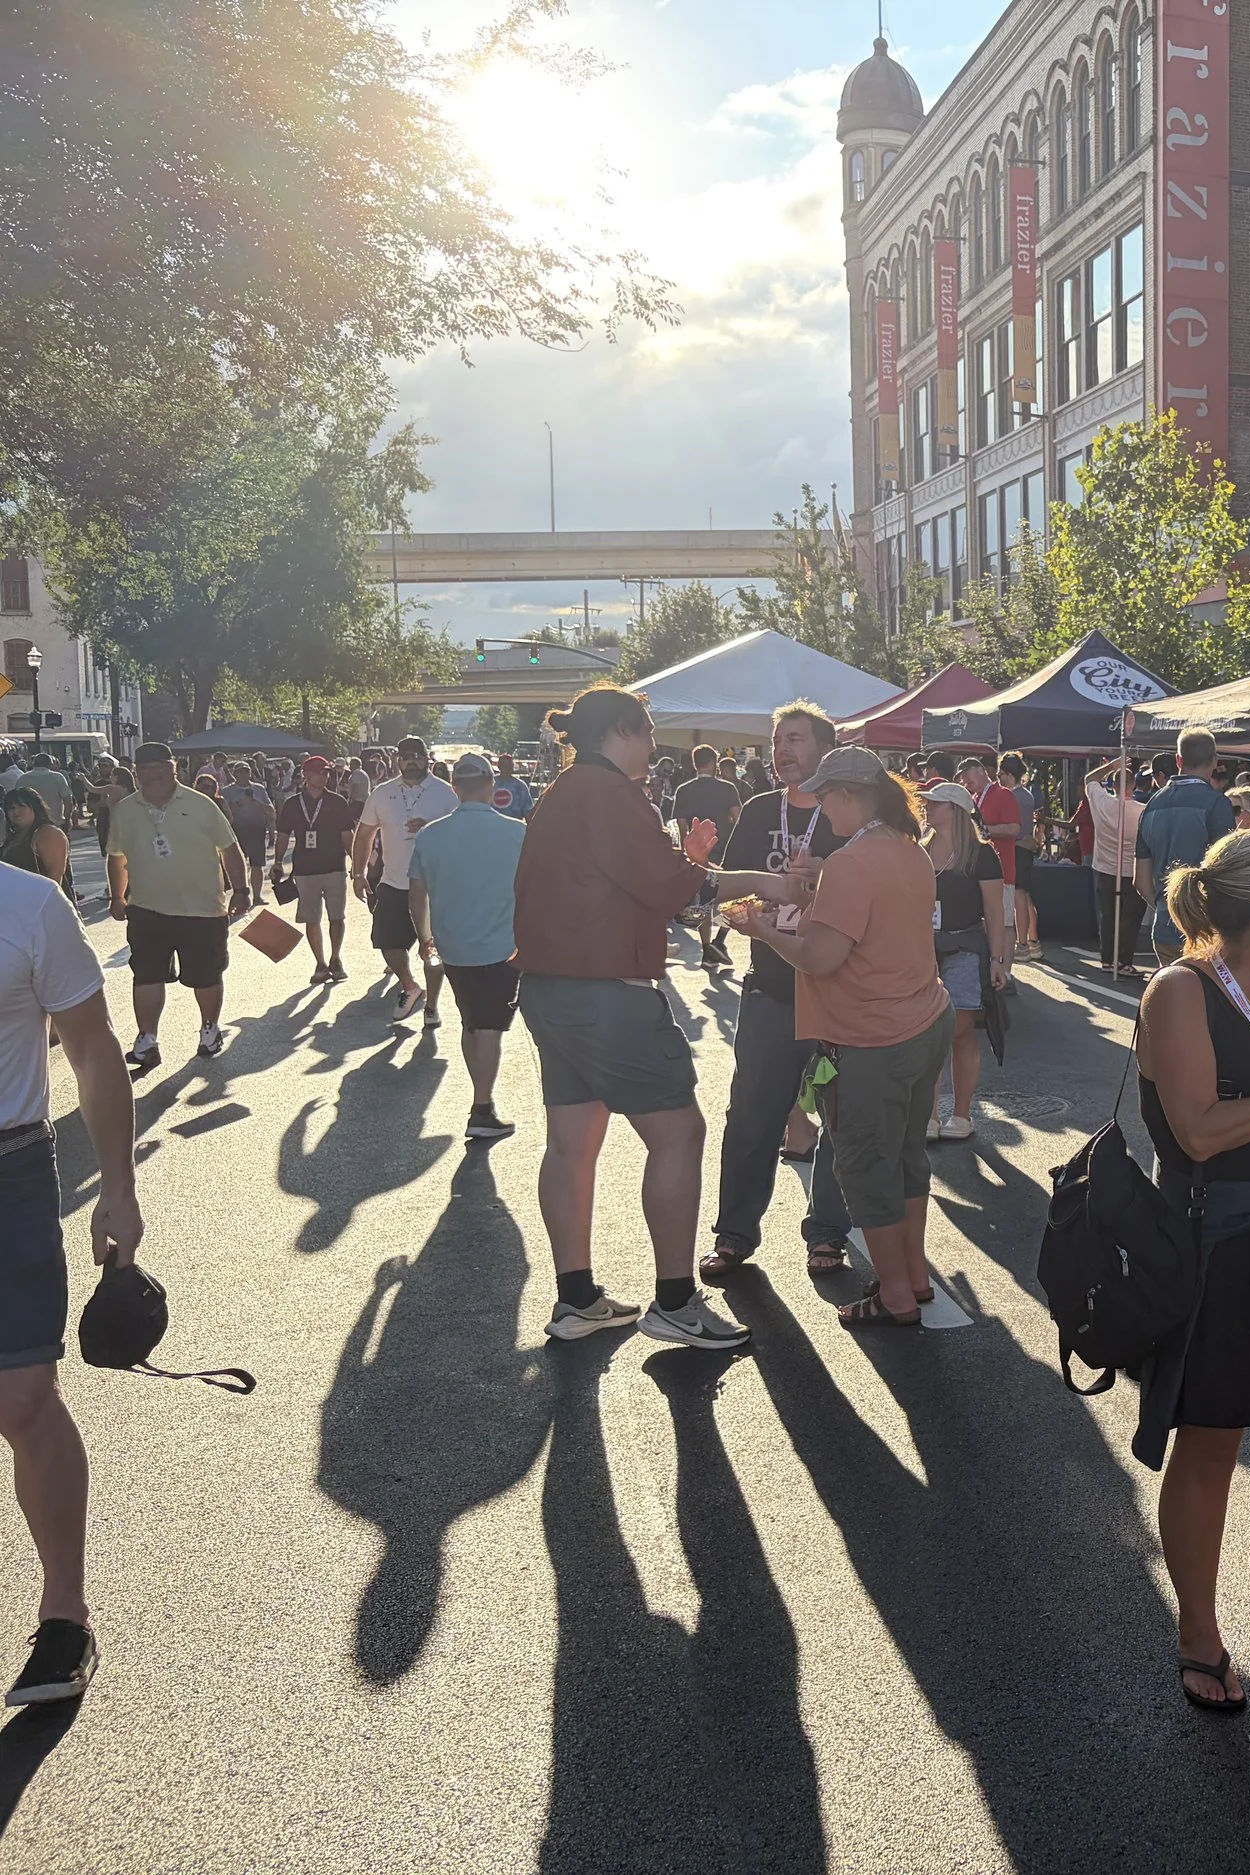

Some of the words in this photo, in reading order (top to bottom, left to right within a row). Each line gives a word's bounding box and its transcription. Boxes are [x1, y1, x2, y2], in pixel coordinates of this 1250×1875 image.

[1015, 194, 1035, 274] frazier
[1166, 0, 1226, 417] razier
[939, 265, 959, 334] frazier
[881, 322, 896, 383] frazier
[1078, 666, 1158, 698] City
[1097, 660, 1128, 672] OUR
